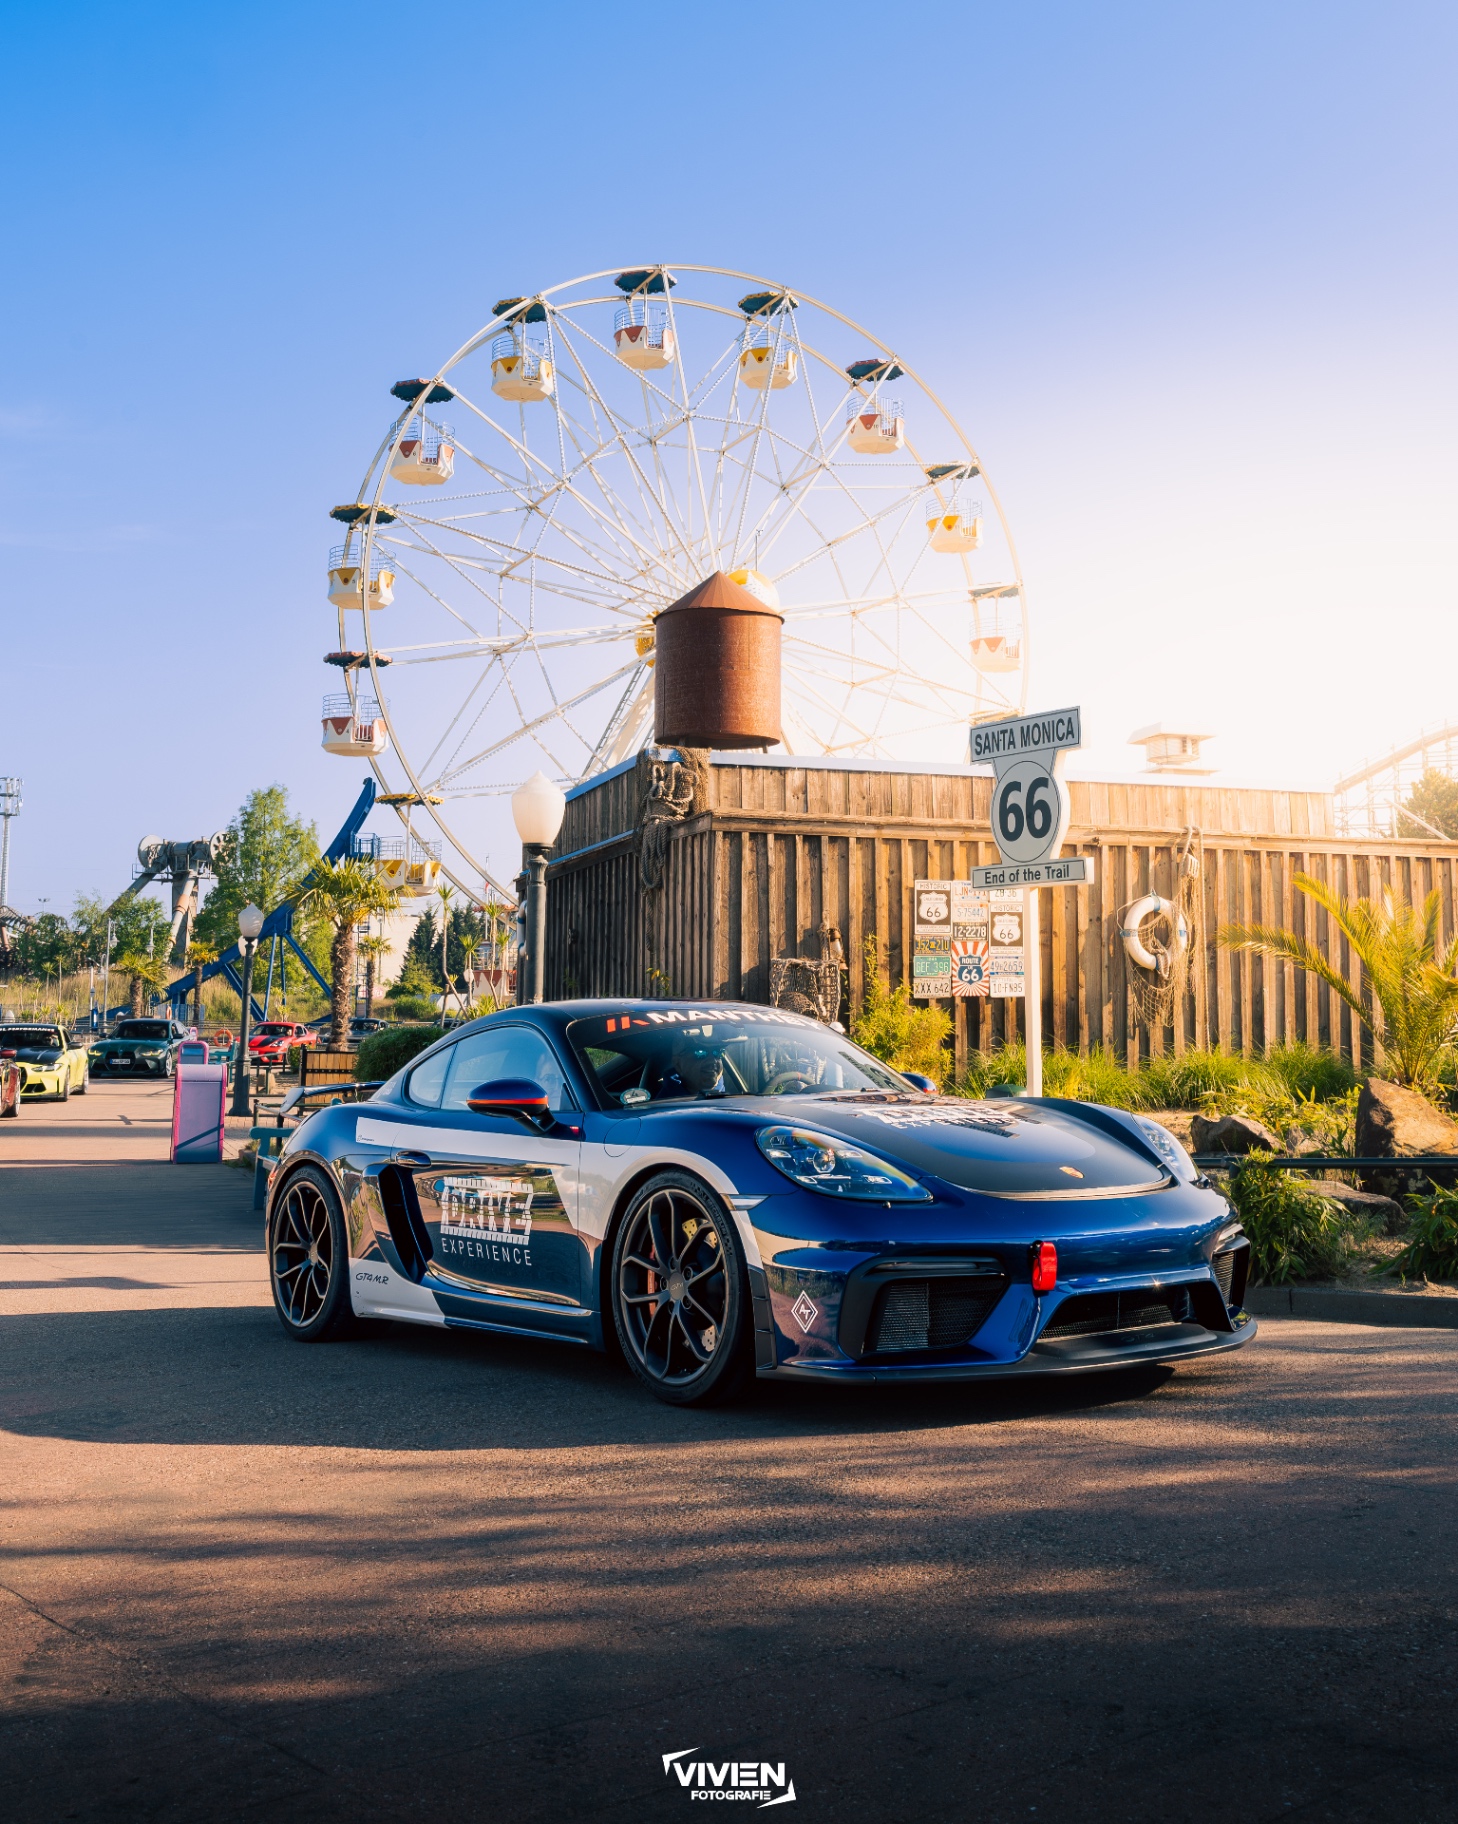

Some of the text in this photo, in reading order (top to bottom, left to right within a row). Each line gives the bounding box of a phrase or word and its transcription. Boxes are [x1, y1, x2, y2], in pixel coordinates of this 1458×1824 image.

[975, 717, 1075, 755] SANTA MONICA
[999, 776, 1051, 842] 66
[985, 864, 1069, 884] End of the Trail
[927, 907, 941, 917] 66
[1000, 929, 1014, 939] 66
[962, 969, 979, 981] 66
[935, 983, 949, 993] 642
[647, 1010, 821, 1030] MANTHEY
[441, 1238, 532, 1266] EXPERIENCE
